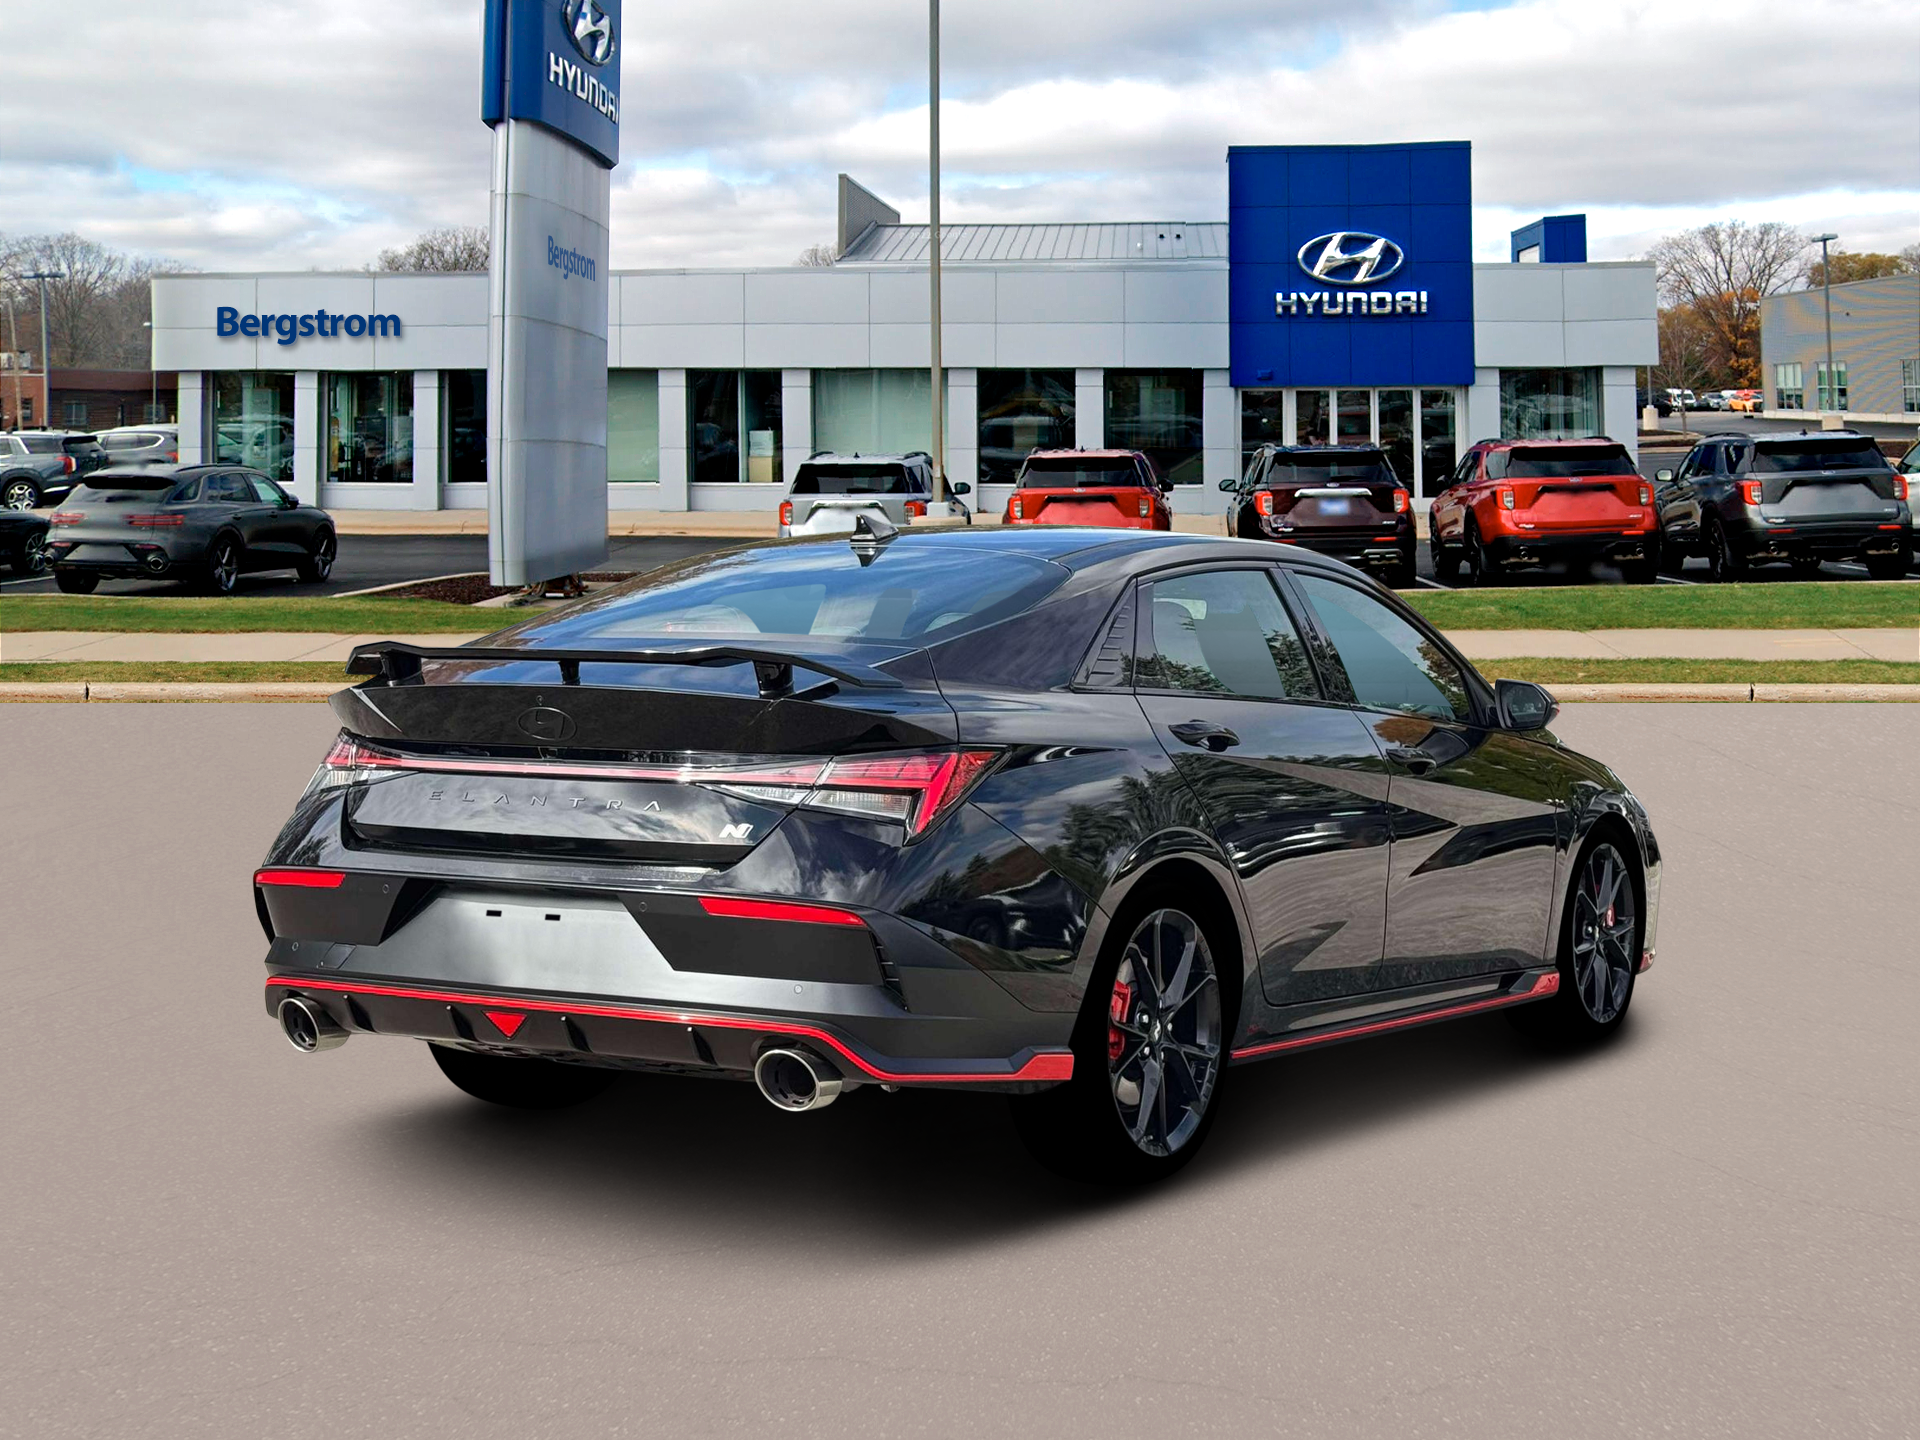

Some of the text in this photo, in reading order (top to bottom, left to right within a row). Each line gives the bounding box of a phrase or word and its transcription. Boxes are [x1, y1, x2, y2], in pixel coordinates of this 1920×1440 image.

[549, 51, 619, 124] HYUNDAI
[547, 235, 596, 282] Bergstrom
[1276, 291, 1428, 315] HYUNDAI
[216, 306, 402, 346] Bergstrom
[429, 790, 662, 813] ELANTRA
